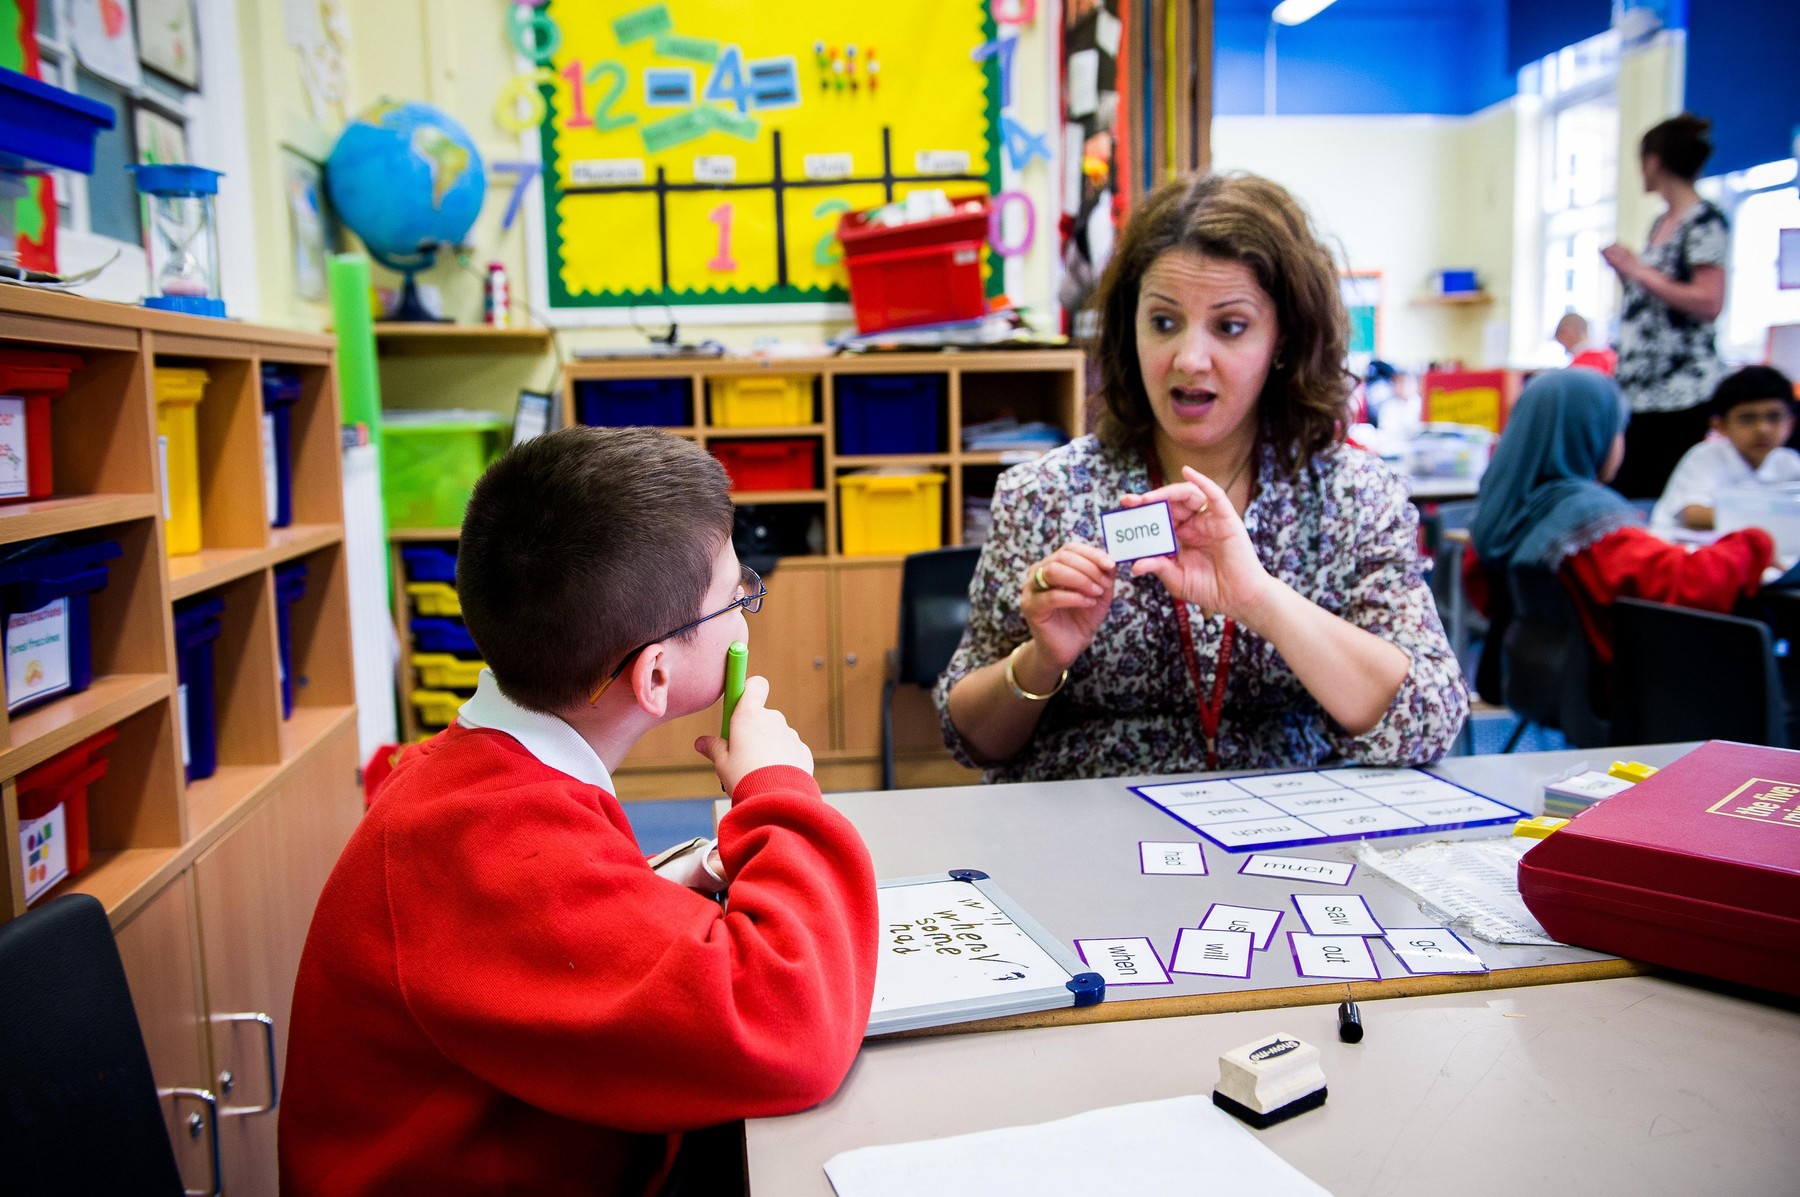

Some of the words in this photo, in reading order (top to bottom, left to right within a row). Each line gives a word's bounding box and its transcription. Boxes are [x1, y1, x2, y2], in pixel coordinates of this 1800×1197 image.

[560, 58, 638, 132] 12
[706, 47, 748, 114] 4
[998, 117, 1051, 171] 4
[491, 161, 545, 229] 7
[989, 191, 1035, 256] 0
[707, 202, 738, 272] 1
[1115, 522, 1160, 543] some
[1753, 786, 1800, 804] five
[1208, 806, 1250, 818] had
[1734, 801, 1781, 817] the
[1340, 815, 1377, 826] got
[1231, 825, 1293, 838] much
[1164, 850, 1187, 867] had
[1263, 861, 1333, 876] much
[957, 898, 1014, 926] will
[1324, 905, 1352, 926] saw
[915, 917, 963, 956] some
[932, 909, 988, 953] when
[1228, 920, 1250, 932] us
[888, 923, 922, 955] had
[1107, 945, 1139, 976] when
[1202, 943, 1230, 961] will
[1321, 945, 1351, 963] out
